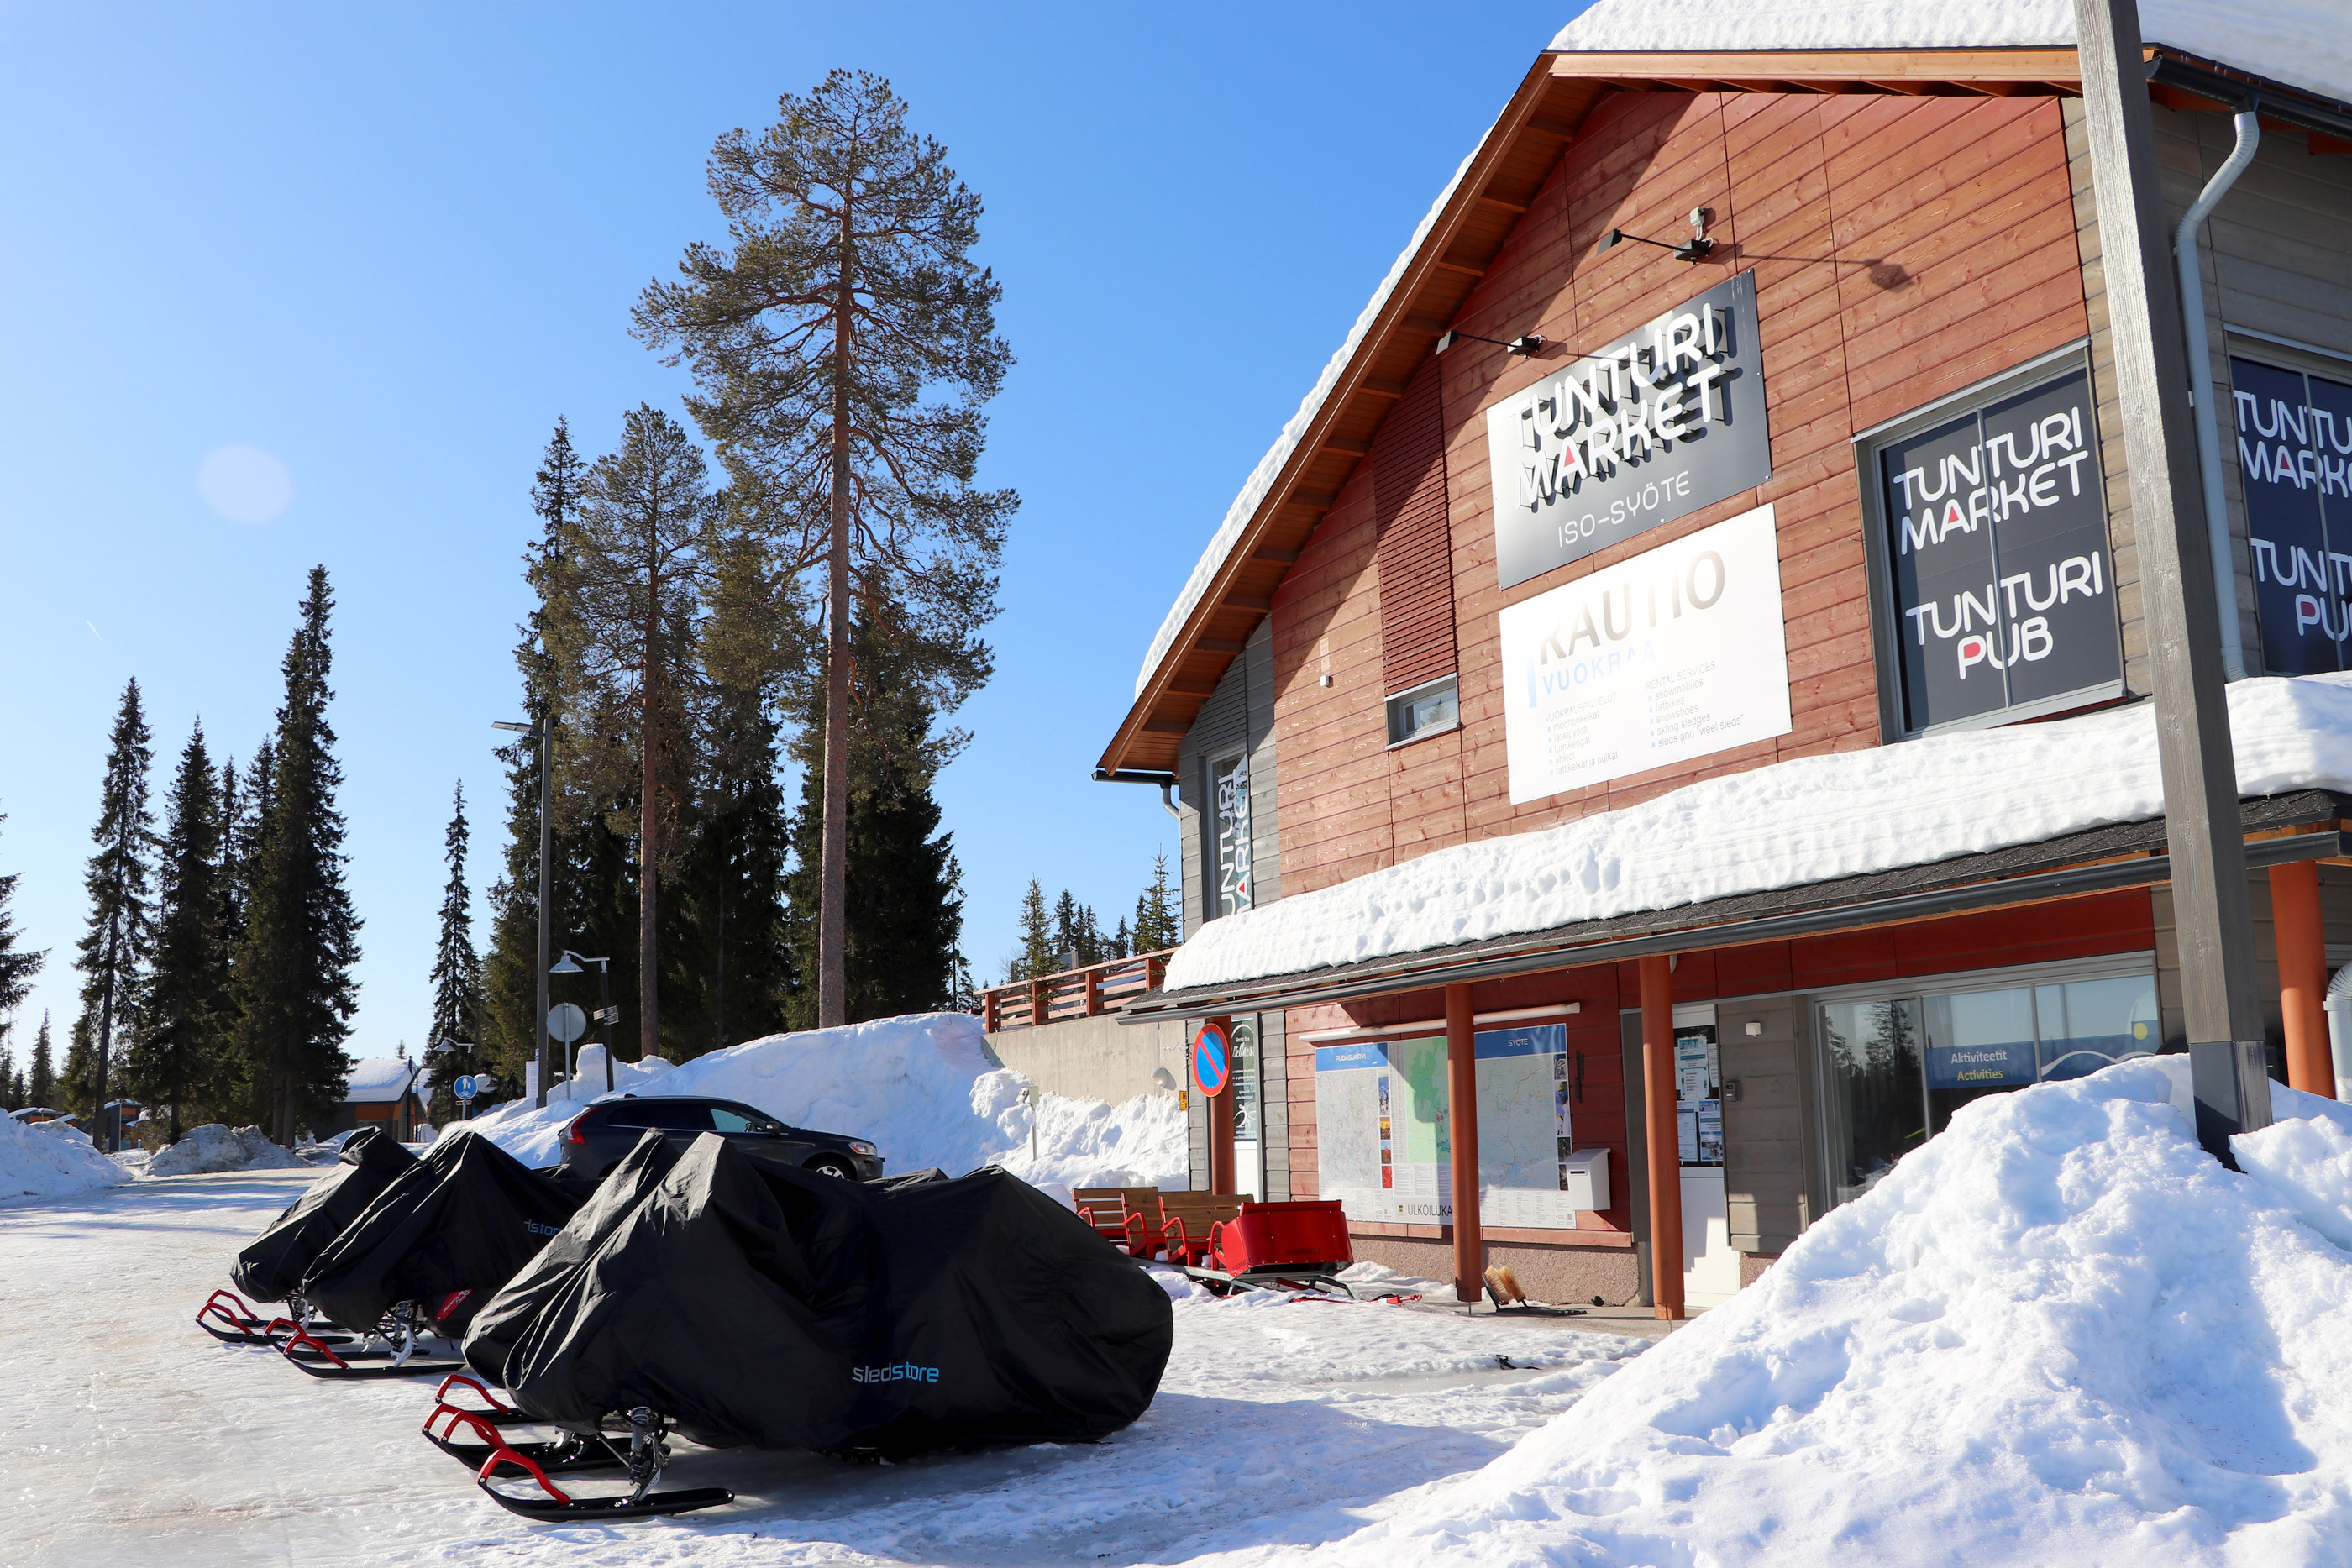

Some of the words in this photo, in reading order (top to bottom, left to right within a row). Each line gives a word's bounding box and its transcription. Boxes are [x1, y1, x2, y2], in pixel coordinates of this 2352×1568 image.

[1508, 302, 1715, 451] TUNTURI
[1514, 364, 1720, 510] MARKET
[2234, 390, 2352, 454] TUNTU
[1893, 406, 2083, 511] TUNTURI
[2238, 436, 2352, 498] MARK
[1558, 471, 1691, 548] ISO-SYÖTE
[1901, 450, 2088, 555] MARKET
[2251, 538, 2352, 595] TUNT
[1541, 550, 1726, 665] RAUTIO
[1905, 551, 2103, 646] TUNTURI
[2296, 594, 2352, 642] PU
[1957, 616, 2055, 680] PUB
[1646, 673, 1675, 690] RENTAL
[1676, 660, 1715, 680] SERVICES
[1654, 677, 1703, 700] snowmobiles
[1545, 692, 1616, 722] VUOKRAUSPALVELUT
[1655, 695, 1684, 712] fatbikes
[1656, 703, 1698, 724] snowshoes
[1657, 721, 1678, 737] skiing
[1680, 711, 1710, 729] sledges
[1588, 756, 1595, 768] ja
[1597, 750, 1618, 764] pulkat
[1657, 733, 1677, 747] sleds
[1679, 728, 1693, 741] and
[1218, 774, 1235, 915] UNTURI
[1950, 1049, 2008, 1064] Aktiviteetit
[1956, 1068, 2003, 1082] Activities
[1407, 1204, 1453, 1216] ULKOILUKA
[852, 1361, 940, 1383] sledstore
